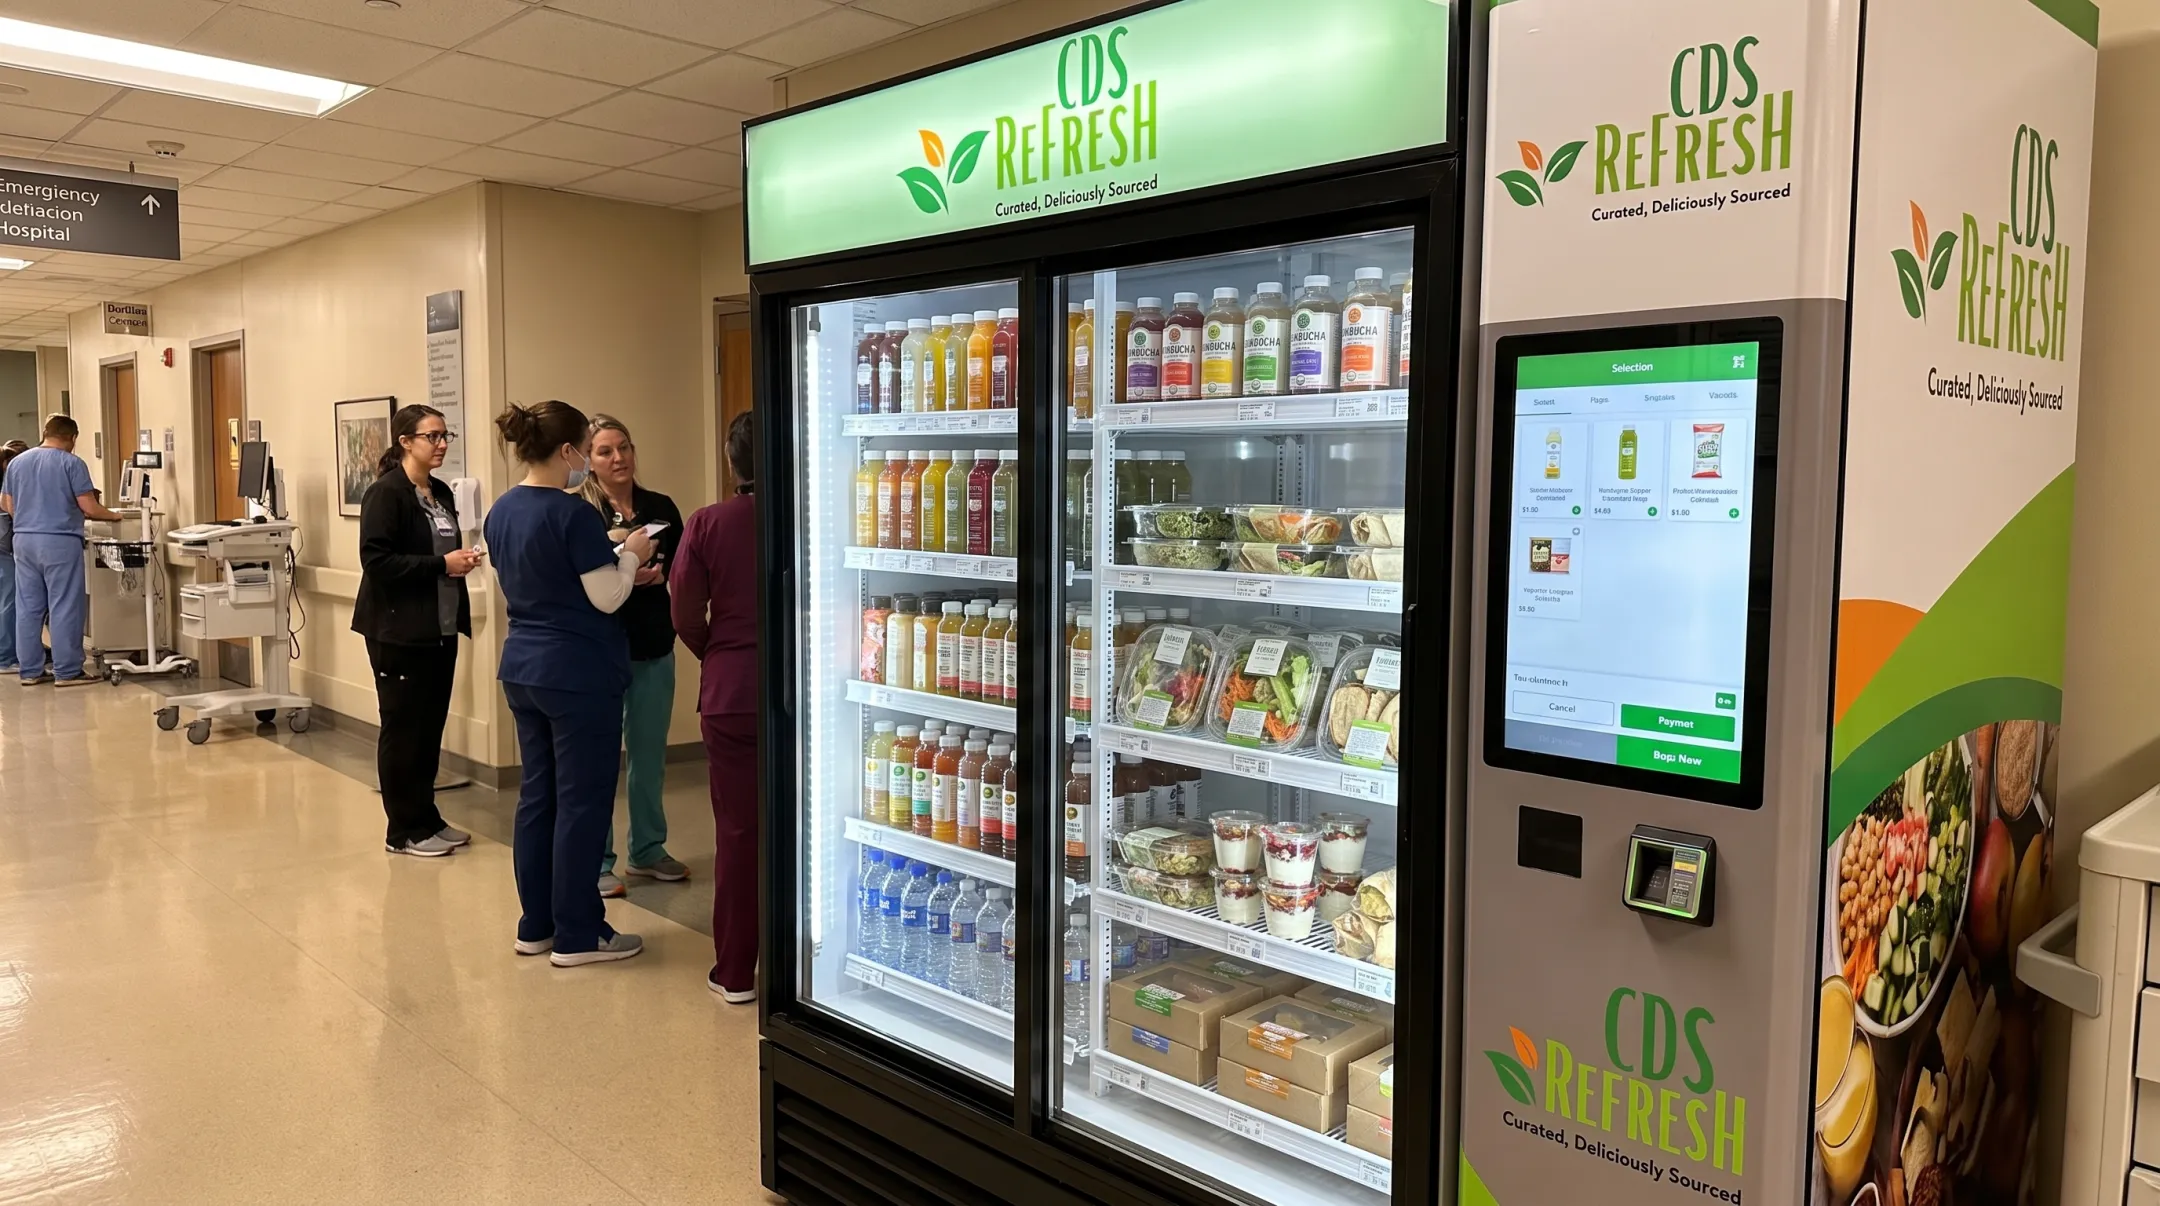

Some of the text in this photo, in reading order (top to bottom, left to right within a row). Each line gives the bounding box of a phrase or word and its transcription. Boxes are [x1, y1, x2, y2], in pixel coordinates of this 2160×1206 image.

[1057, 25, 1130, 110] CDS
[1670, 36, 1760, 118] CDS
[995, 173, 1159, 217] Curated, Deliciously Sourced
[1591, 182, 1791, 221] Curated, Deliciously Sourced
[2010, 123, 2059, 255] CDS
[1612, 362, 1653, 373] Selection
[1928, 367, 2063, 415] Curated, Deliciously Sourced
[1549, 703, 1576, 713] Cancel
[1605, 986, 1715, 1094] CDS
[1502, 1110, 1742, 1206] Curated, Deliciously Sourced
